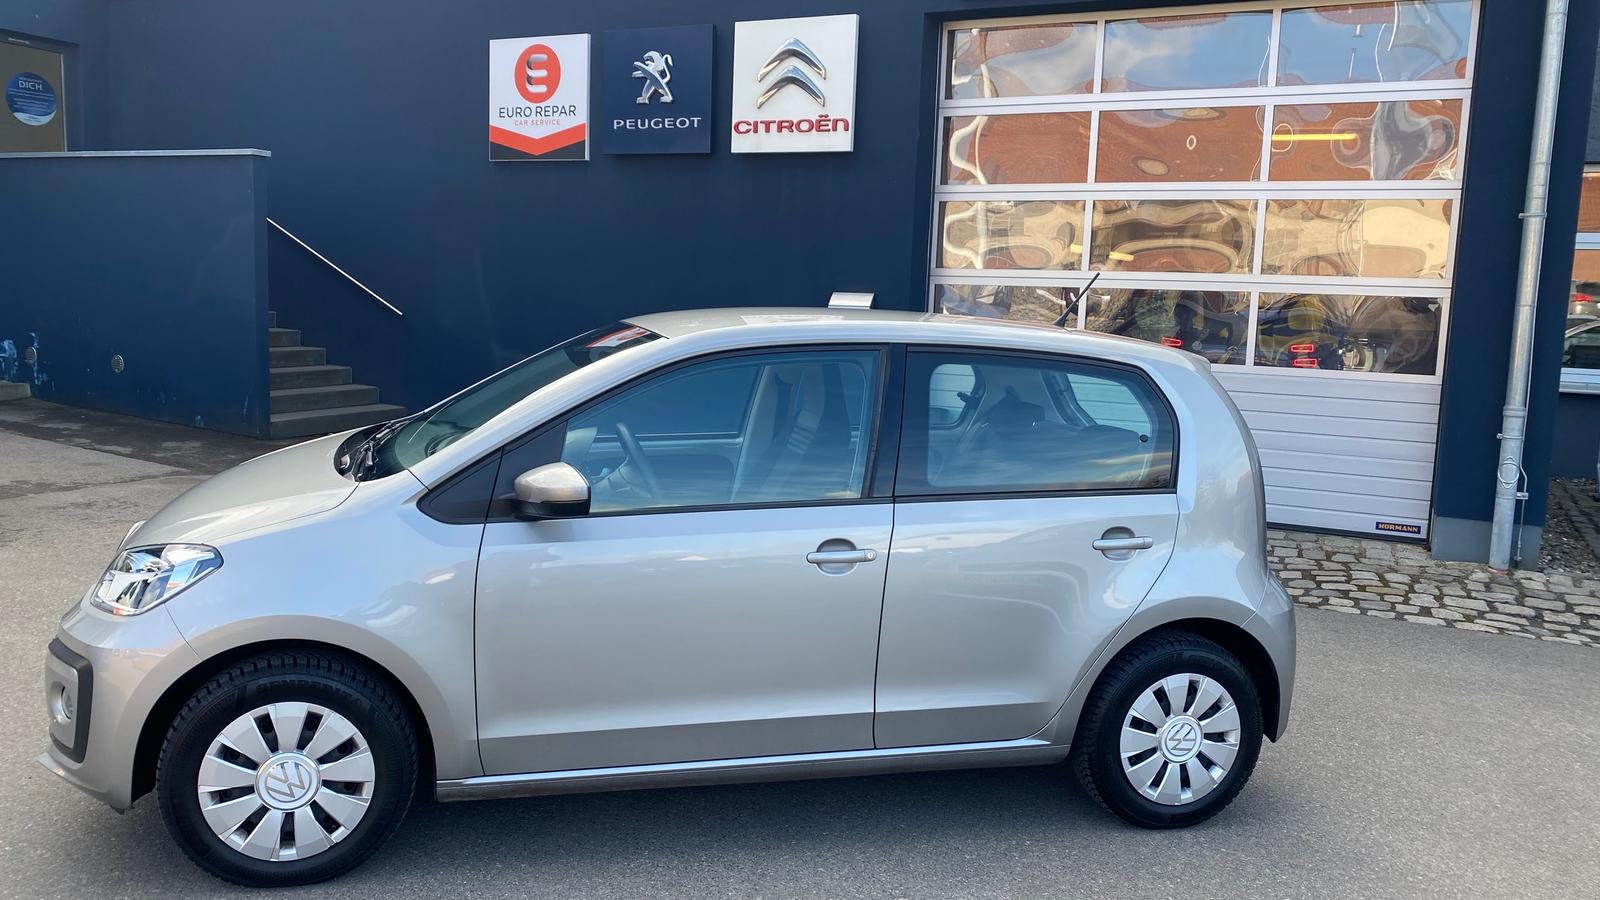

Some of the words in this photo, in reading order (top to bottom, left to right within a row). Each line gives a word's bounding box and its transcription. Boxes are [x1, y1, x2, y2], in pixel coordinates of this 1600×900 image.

[18, 80, 43, 91] DICH
[499, 106, 533, 118] EURO
[535, 105, 577, 117] REPAR
[515, 119, 528, 127] CAR
[613, 117, 702, 130] PEUGEOT
